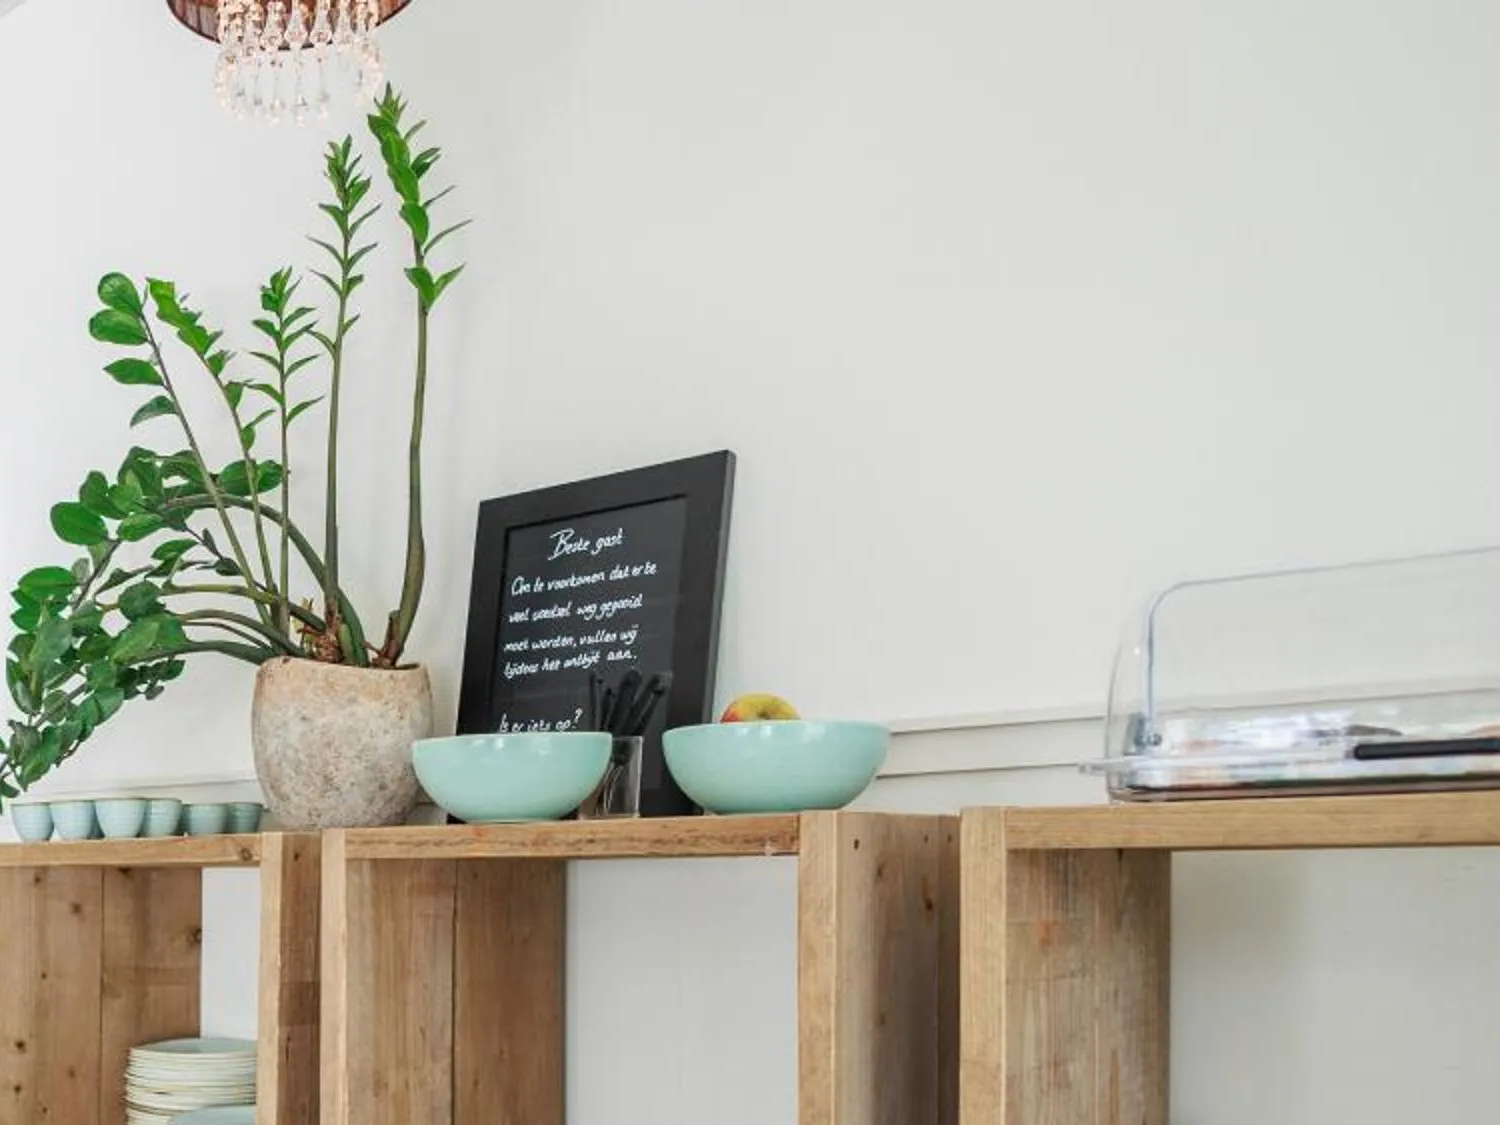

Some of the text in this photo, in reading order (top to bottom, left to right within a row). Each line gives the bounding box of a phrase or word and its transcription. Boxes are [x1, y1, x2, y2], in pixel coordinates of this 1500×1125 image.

[548, 528, 623, 560] Beste gast
[511, 576, 531, 596] Om
[533, 576, 545, 593] te
[547, 571, 606, 591] voorkomen
[609, 563, 629, 580] dat
[632, 565, 644, 577] er
[577, 603, 597, 621] weg
[595, 593, 643, 621] gegooid
[503, 638, 529, 652] moet
[579, 628, 618, 645] vullen
[541, 657, 562, 671] het
[563, 650, 601, 669] ontbijt
[511, 722, 525, 731] er
[527, 719, 550, 731] iets
